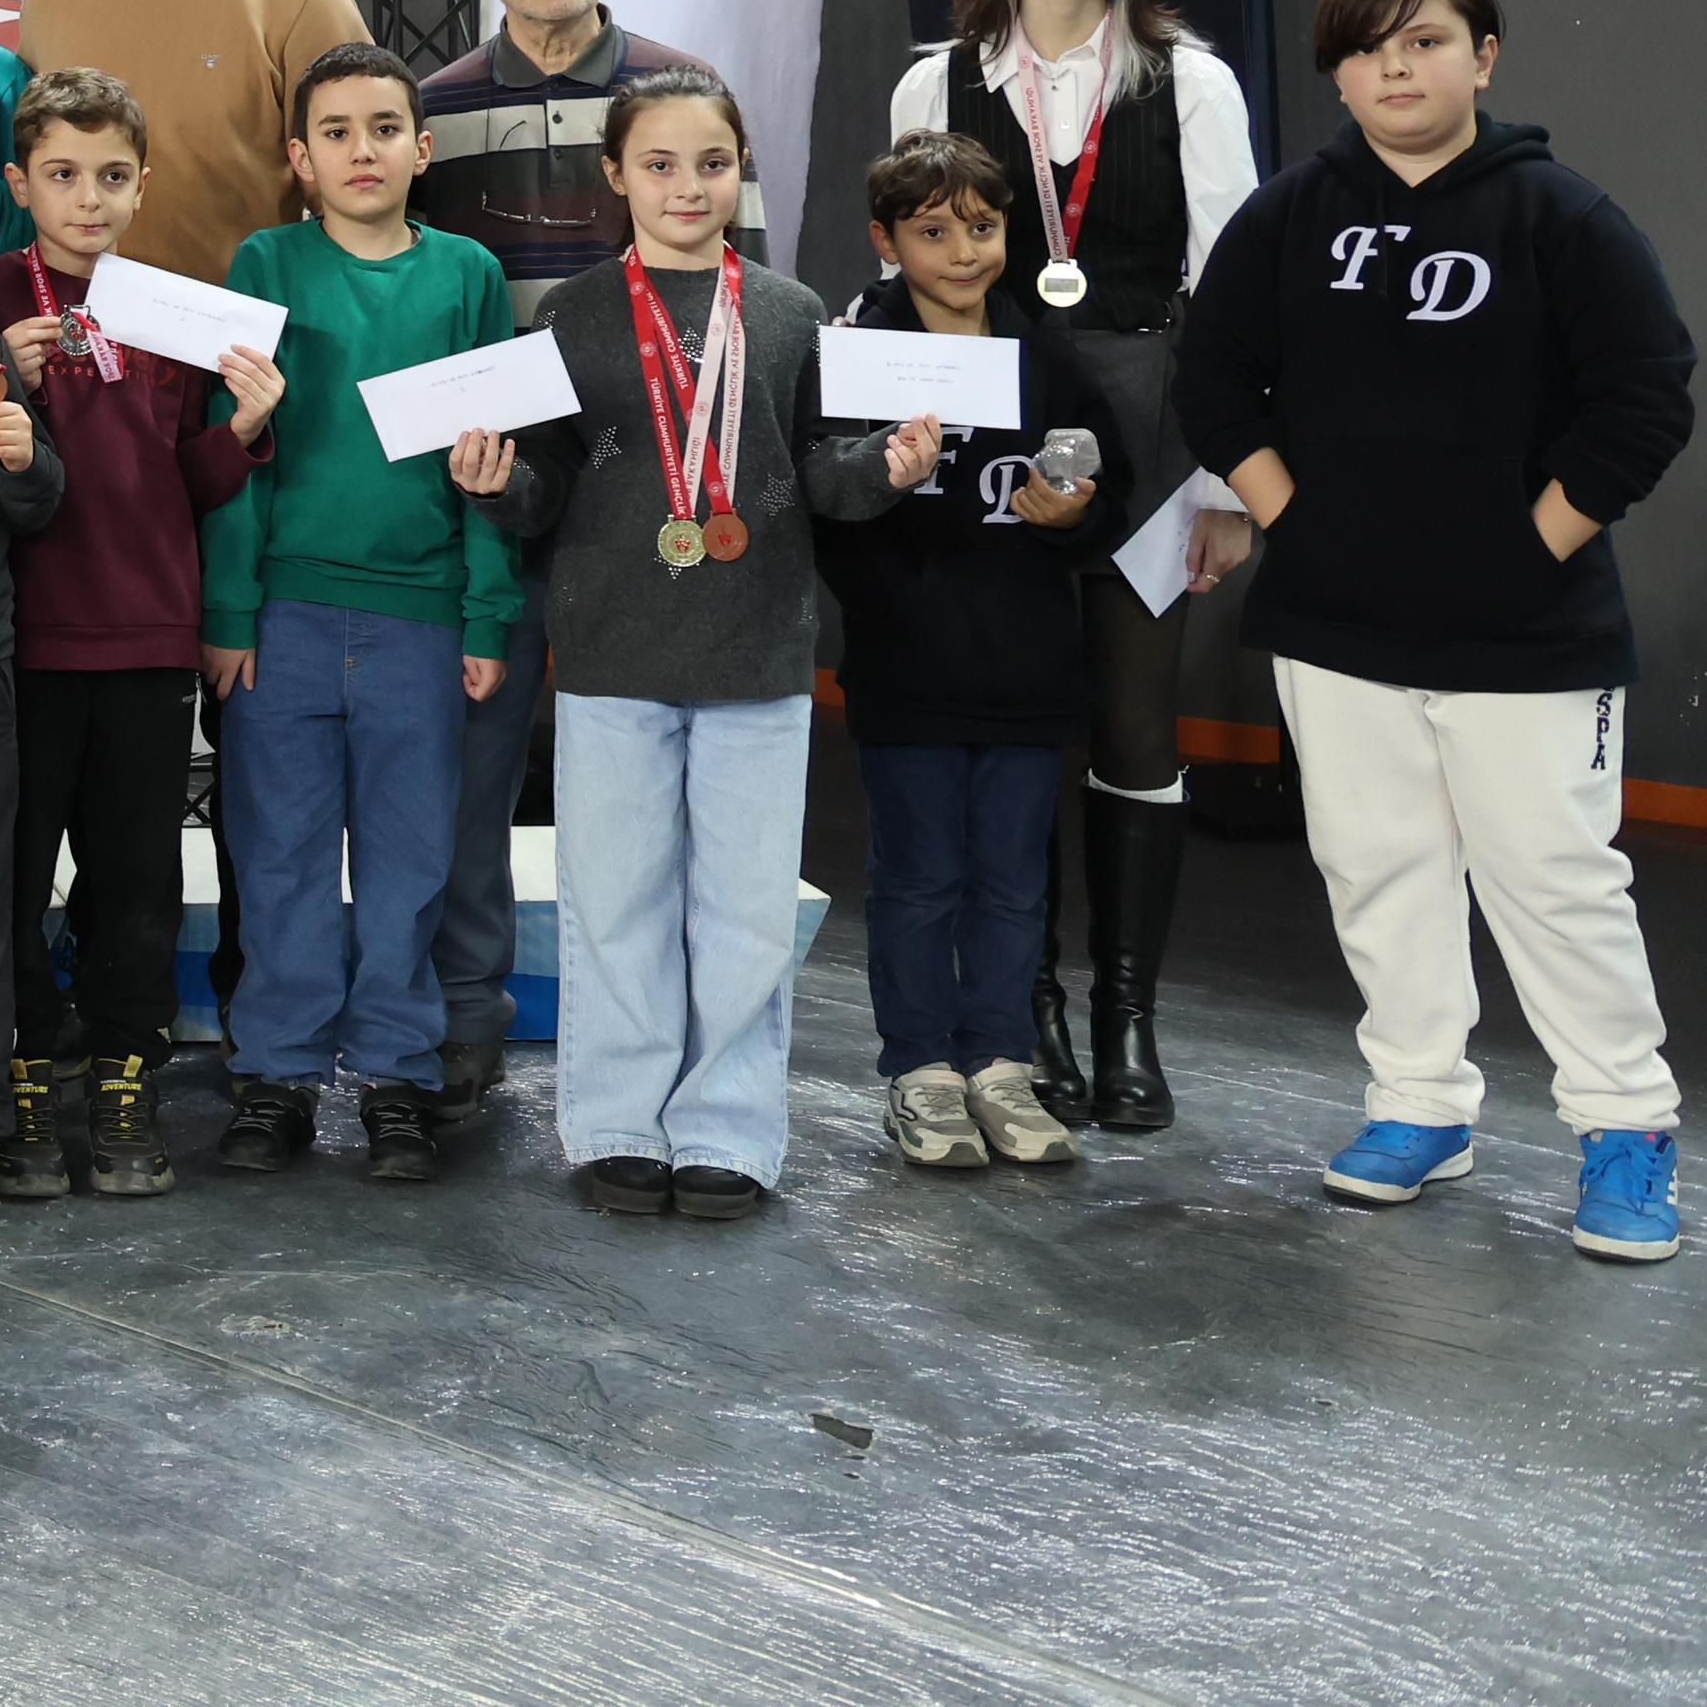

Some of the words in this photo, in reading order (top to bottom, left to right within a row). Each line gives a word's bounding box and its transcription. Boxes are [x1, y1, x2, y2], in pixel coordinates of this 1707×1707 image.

[1330, 223, 1411, 290] F
[1405, 249, 1492, 323] D
[650, 377, 665, 413] TÜRKİYE
[658, 415, 679, 476] CUMHURİYETİ
[671, 477, 686, 515] GENÇLİK
[100, 1082, 143, 1092] ADVENTURE
